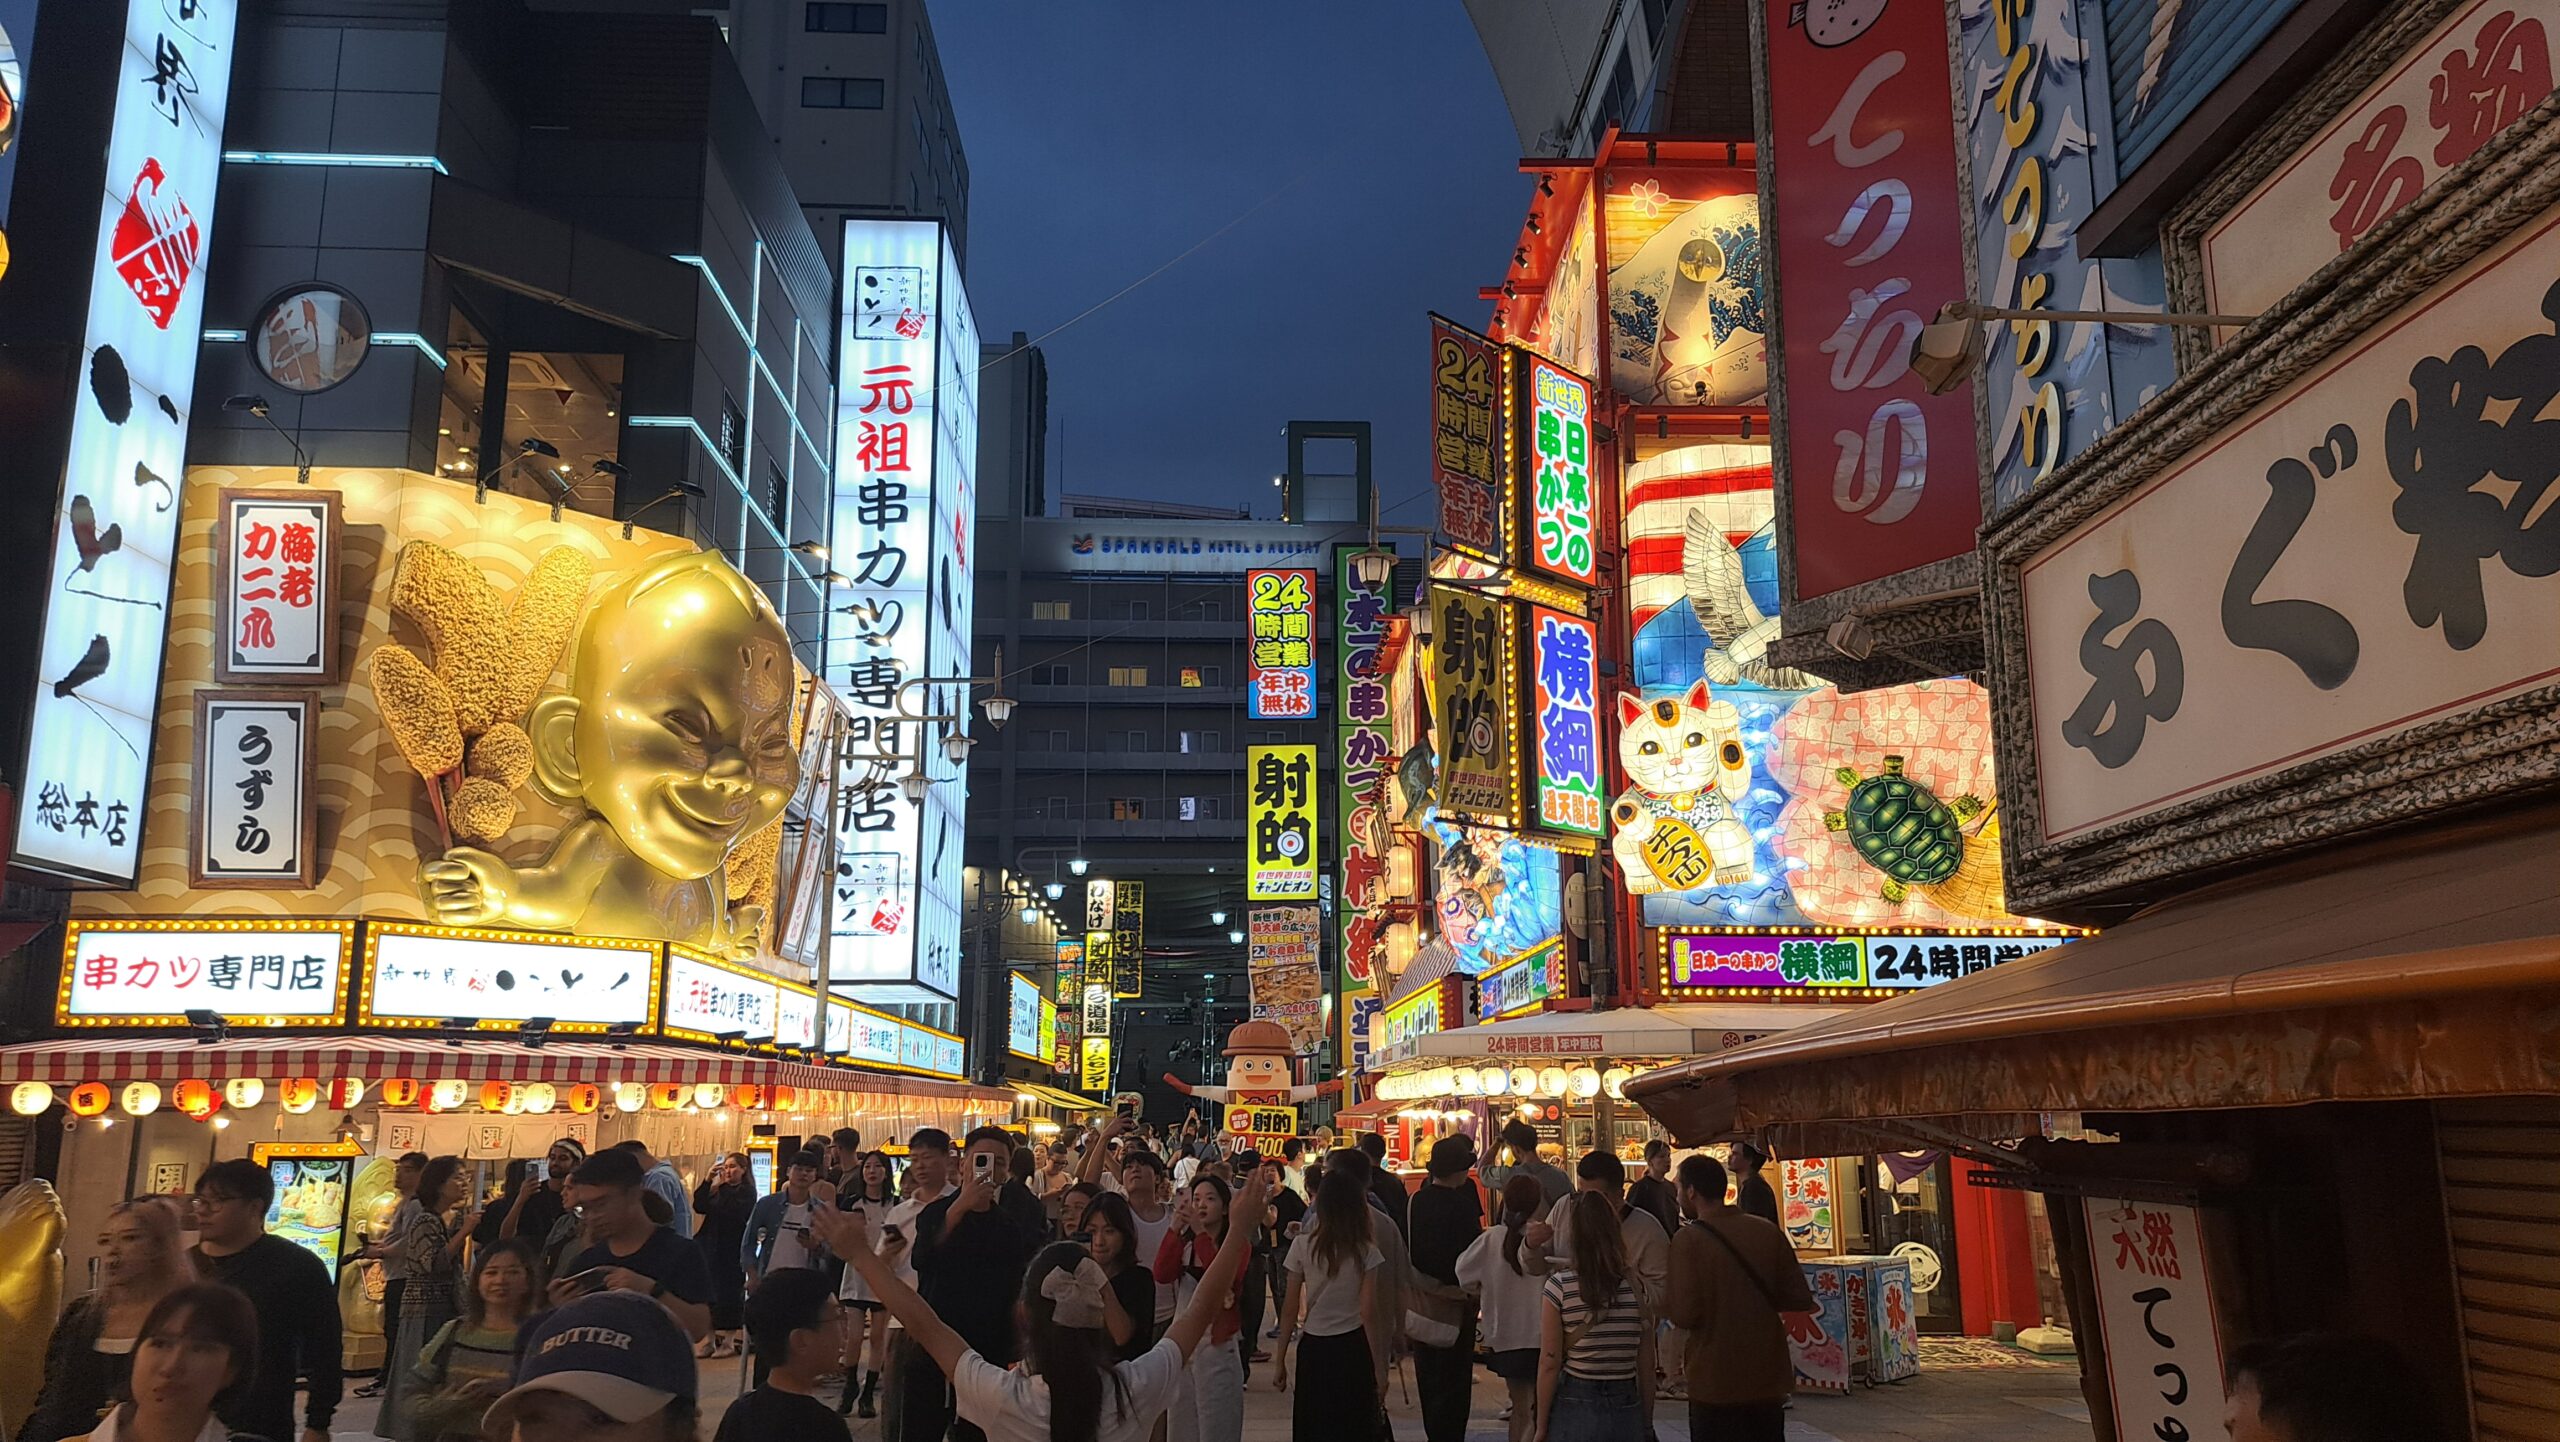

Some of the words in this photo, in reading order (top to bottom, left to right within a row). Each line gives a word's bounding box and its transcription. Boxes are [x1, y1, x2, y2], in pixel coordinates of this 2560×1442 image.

[1437, 338, 1494, 404] 24
[1537, 370, 1584, 418] 新世界
[1437, 390, 1493, 444] 時間
[1437, 430, 1495, 485] 営業
[1442, 477, 1490, 513] 年中
[1538, 409, 1563, 562] 串かつ
[1566, 420, 1590, 571] 日本一の
[1101, 538, 1202, 555] SPAWORLD
[1441, 507, 1493, 546] 無休
[239, 521, 277, 649] カニ爪
[280, 522, 316, 609] 海老
[841, 365, 914, 833] 元祖串カツ専門店
[1253, 577, 1309, 611] 24
[1255, 614, 1308, 639] 時間
[1254, 641, 1310, 668] 営業
[1262, 673, 1308, 693] 年中
[1262, 695, 1309, 713] 無休
[1442, 598, 1501, 770] 射的
[1540, 620, 1597, 789] 横綱
[235, 724, 274, 855] うずら
[1254, 753, 1312, 866] 射的
[1449, 787, 1504, 809] チャンピオン
[1543, 789, 1600, 829] 通天閣店
[37, 780, 130, 848] 総本店
[1647, 824, 1707, 886] 千万両
[1089, 884, 1104, 928] わなげ
[1256, 881, 1313, 892] チャンピオン
[1252, 912, 1281, 922] 新世界
[83, 954, 327, 991] 串カツ専門店
[1674, 938, 1690, 983] 新世界
[1691, 951, 1778, 972] 日本一の串かつ
[1779, 941, 1860, 982] 横綱
[1487, 1035, 1555, 1053] 24時間営業
[1559, 1035, 1602, 1050] 年中無休
[1253, 1112, 1291, 1133] 射的
[1804, 1180, 1827, 1200] 氷
